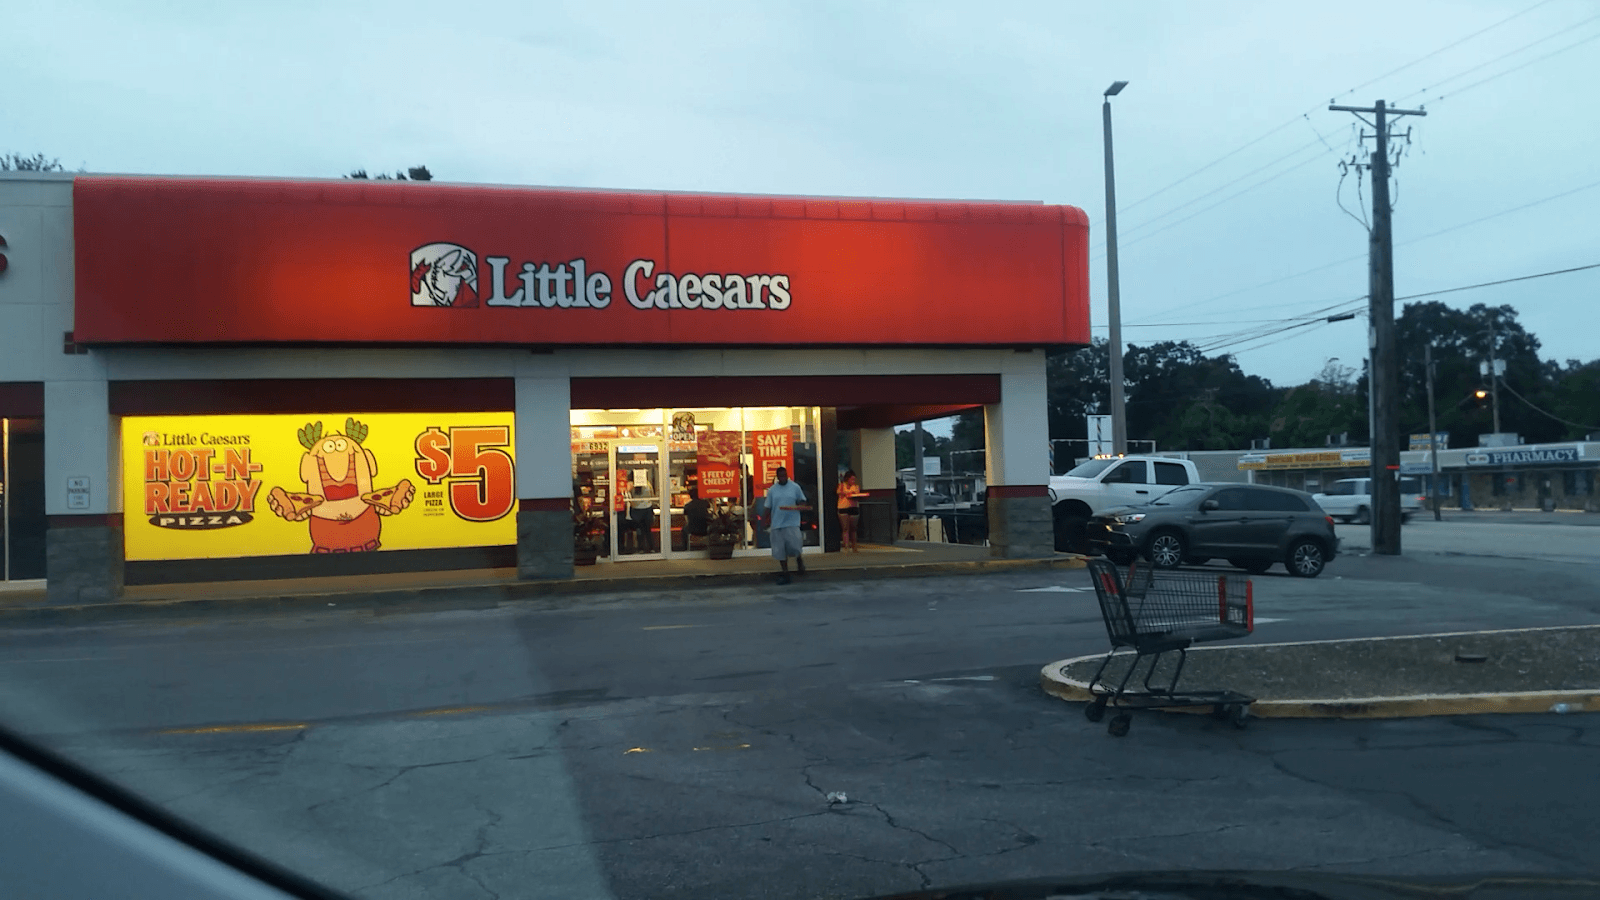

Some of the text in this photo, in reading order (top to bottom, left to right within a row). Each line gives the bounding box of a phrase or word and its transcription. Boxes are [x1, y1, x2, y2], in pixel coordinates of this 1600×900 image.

[486, 255, 791, 310] Little Caesars
[163, 432, 251, 446] Little Caesars
[672, 432, 695, 441] OPEN
[757, 434, 788, 446] SAVE
[589, 441, 608, 450] 6932
[757, 446, 788, 457] TIME
[1493, 449, 1575, 463] PHARMACY
[144, 448, 263, 481] HOT-N-
[414, 425, 516, 523] $5
[707, 470, 724, 478] FEET
[725, 470, 735, 478] OF
[703, 478, 734, 486] CHEESY!
[144, 480, 262, 515] READY
[423, 491, 444, 499] LARGE
[425, 499, 443, 507] PIZZA
[160, 515, 243, 526] PIZZA
